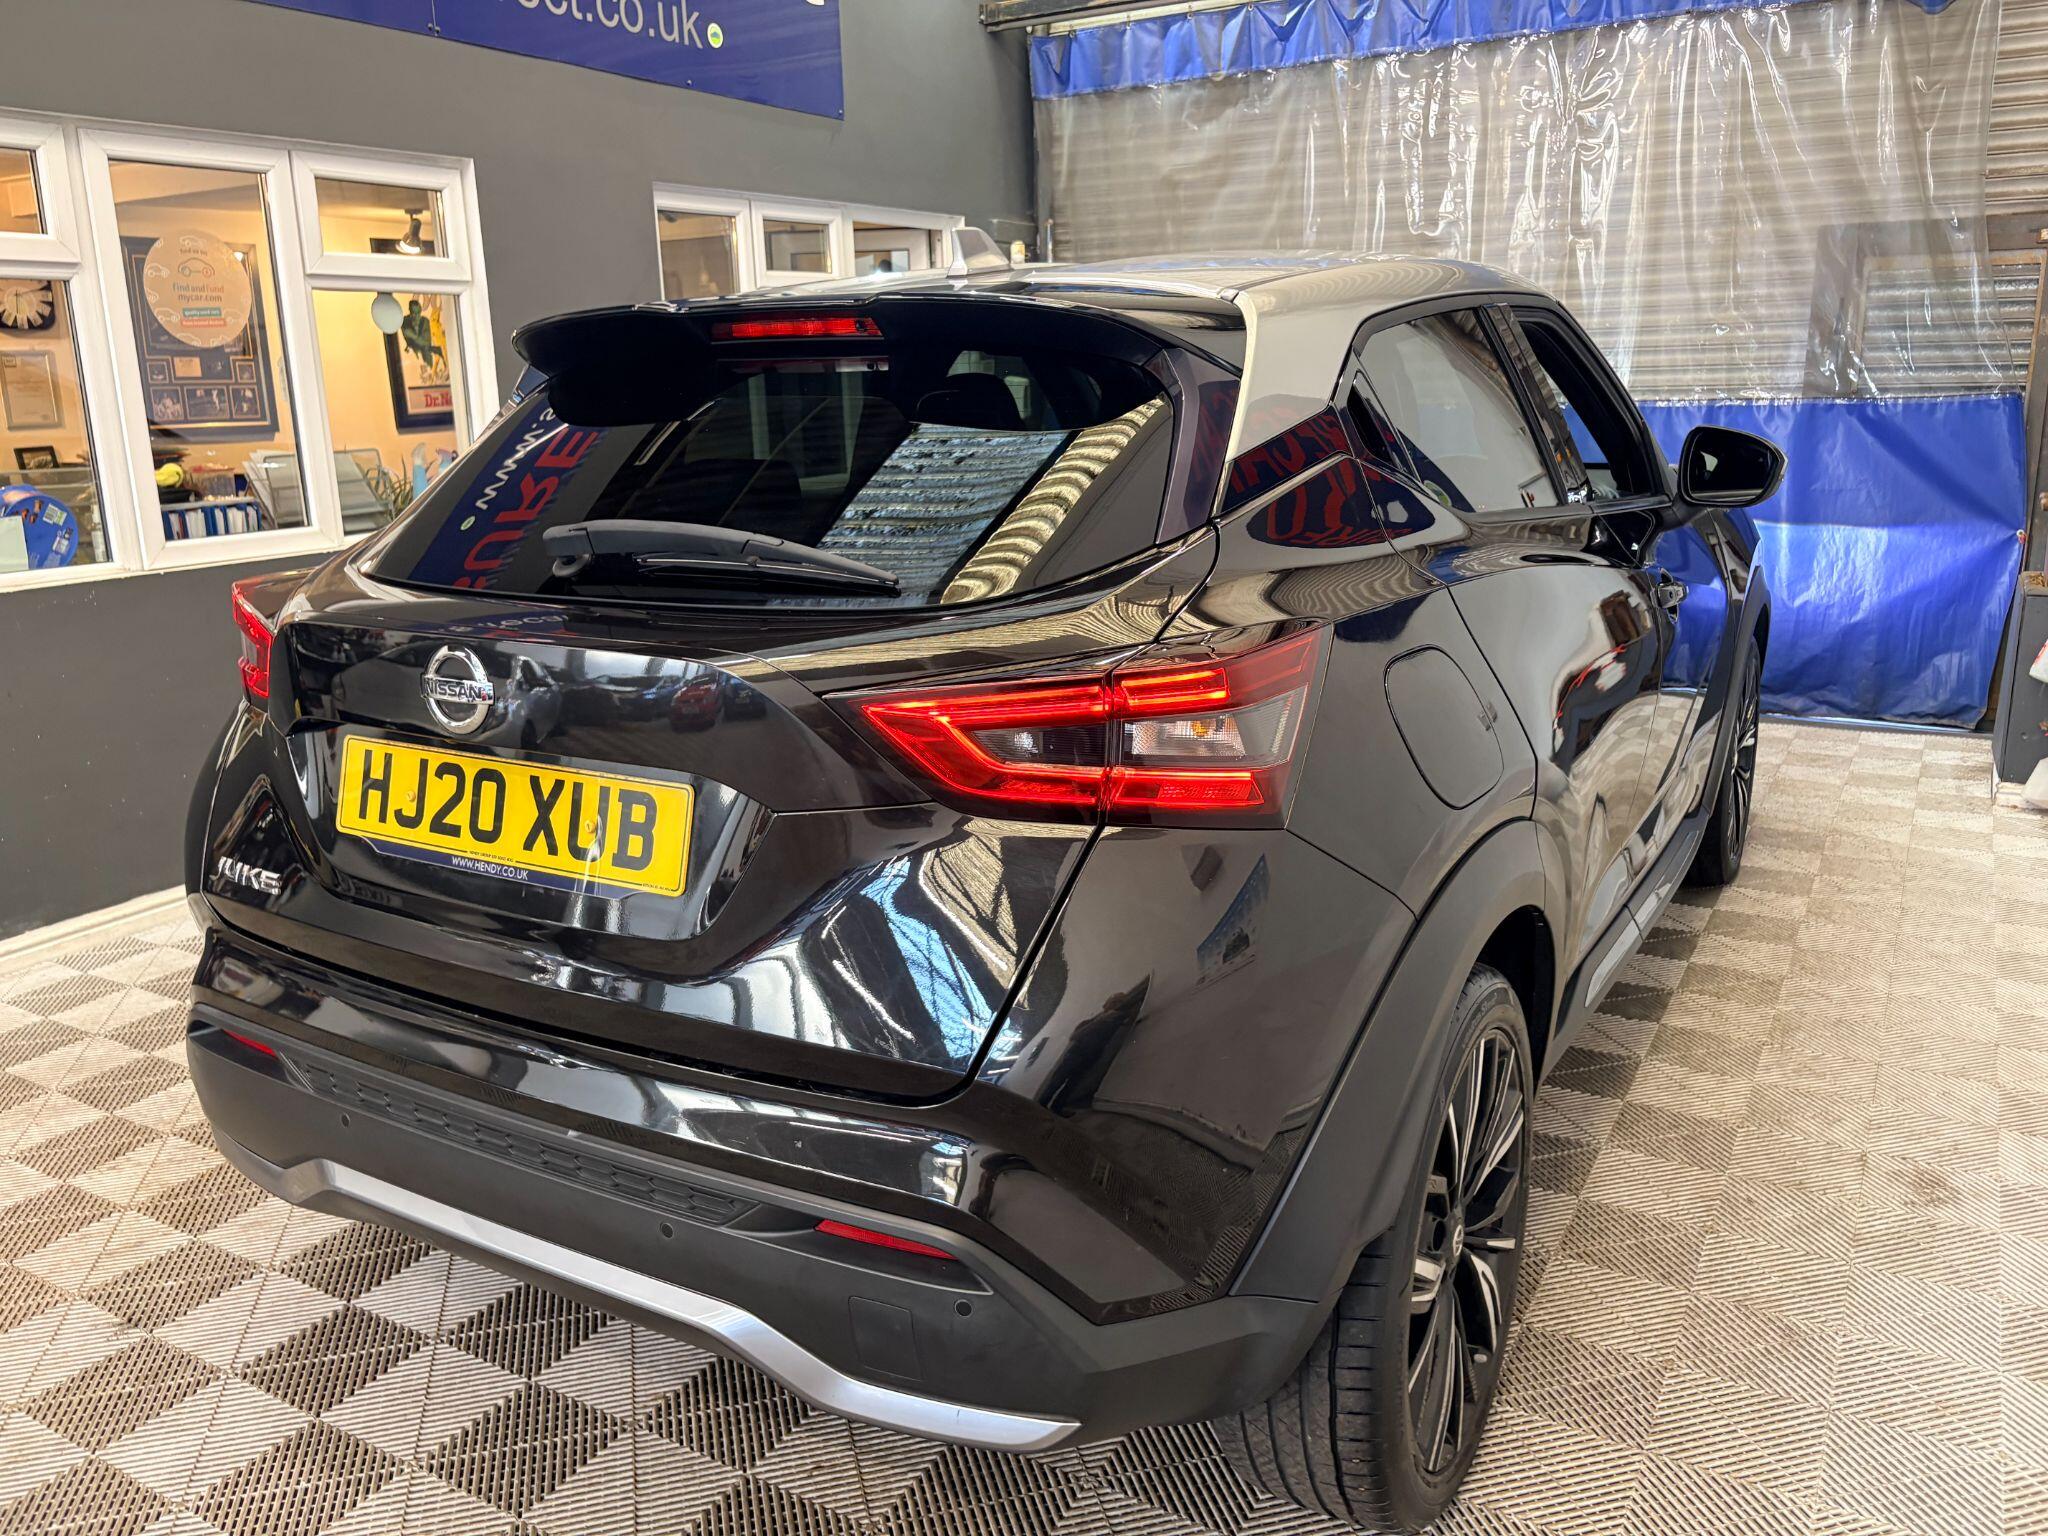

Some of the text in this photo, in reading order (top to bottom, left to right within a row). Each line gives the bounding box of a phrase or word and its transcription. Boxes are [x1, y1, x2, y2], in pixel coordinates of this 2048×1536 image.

[424, 677, 482, 700] NISSAN
[358, 749, 658, 871] HJ20 XUB
[209, 856, 281, 896] JUKE
[451, 855, 529, 880] WWW.HENDY.CO.UK
